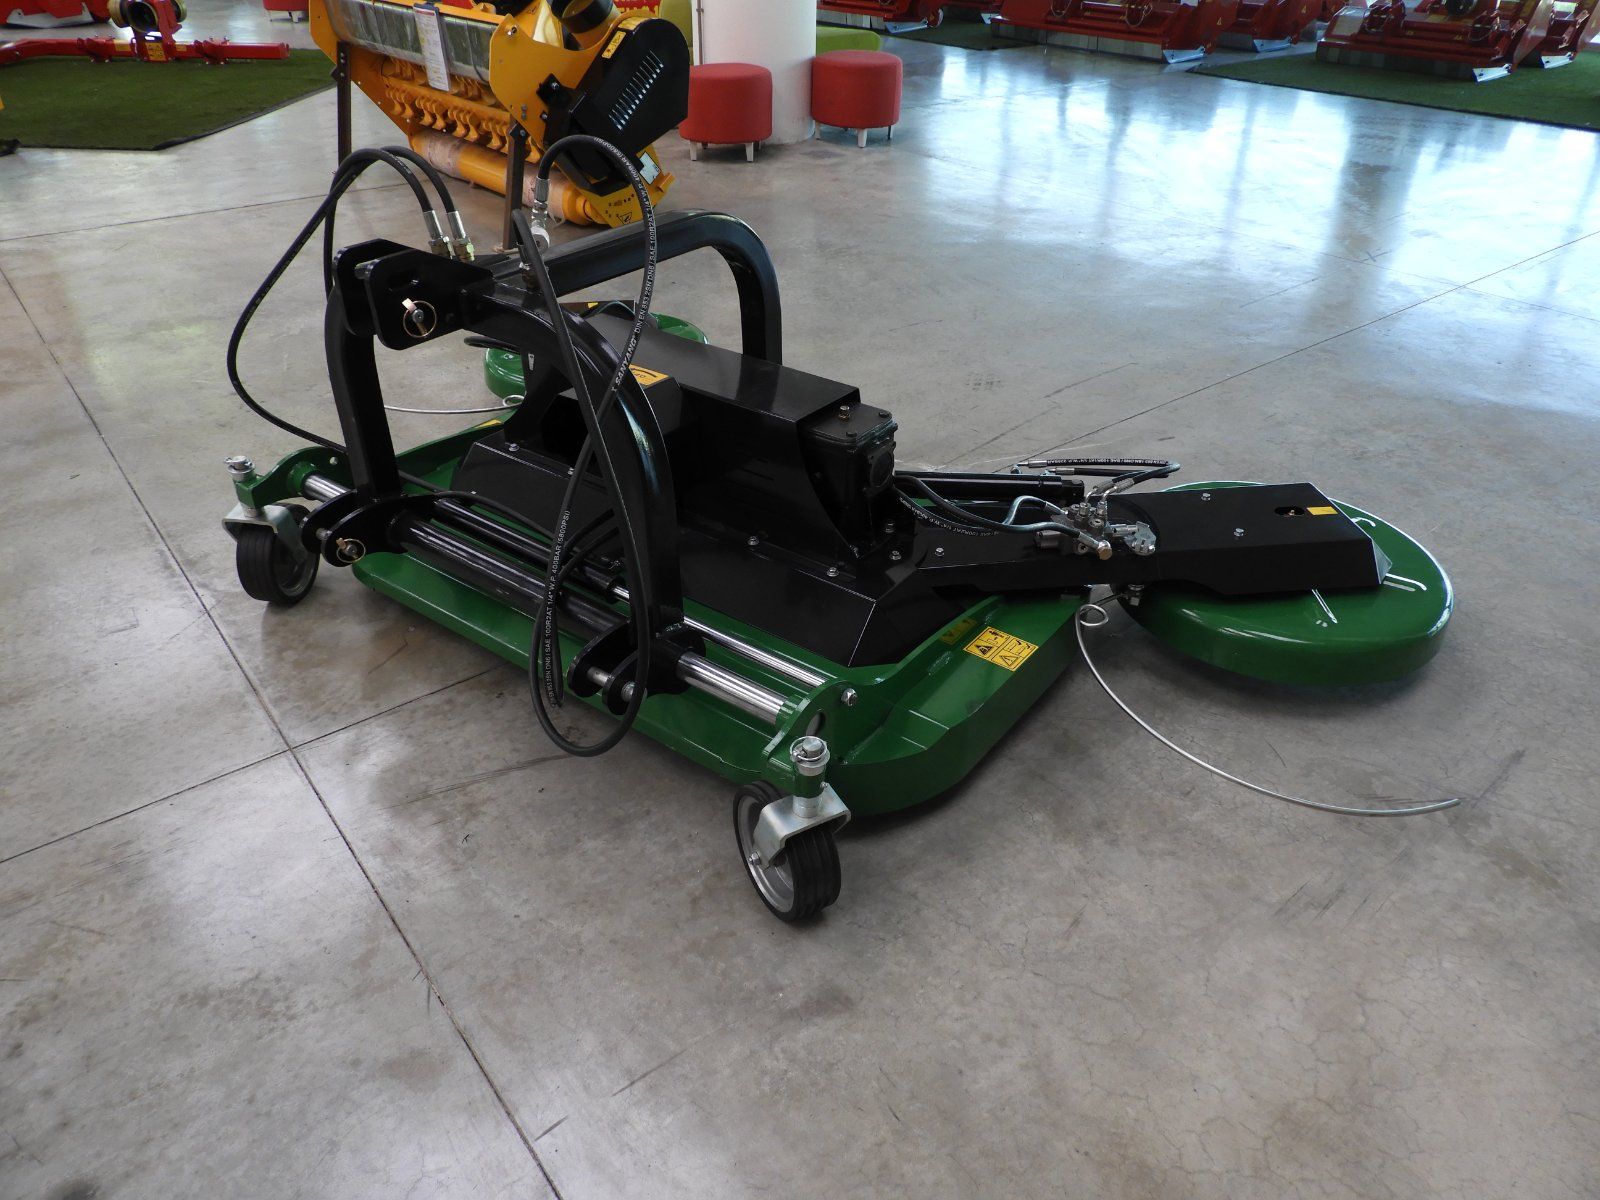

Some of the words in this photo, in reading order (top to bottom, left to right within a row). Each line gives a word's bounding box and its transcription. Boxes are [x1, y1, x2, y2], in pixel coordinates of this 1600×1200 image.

[641, 296, 649, 309] 853
[639, 309, 647, 320] EN
[634, 320, 643, 333] DIN
[545, 607, 553, 637] 100R2AT
[552, 545, 562, 573] 400BAR
